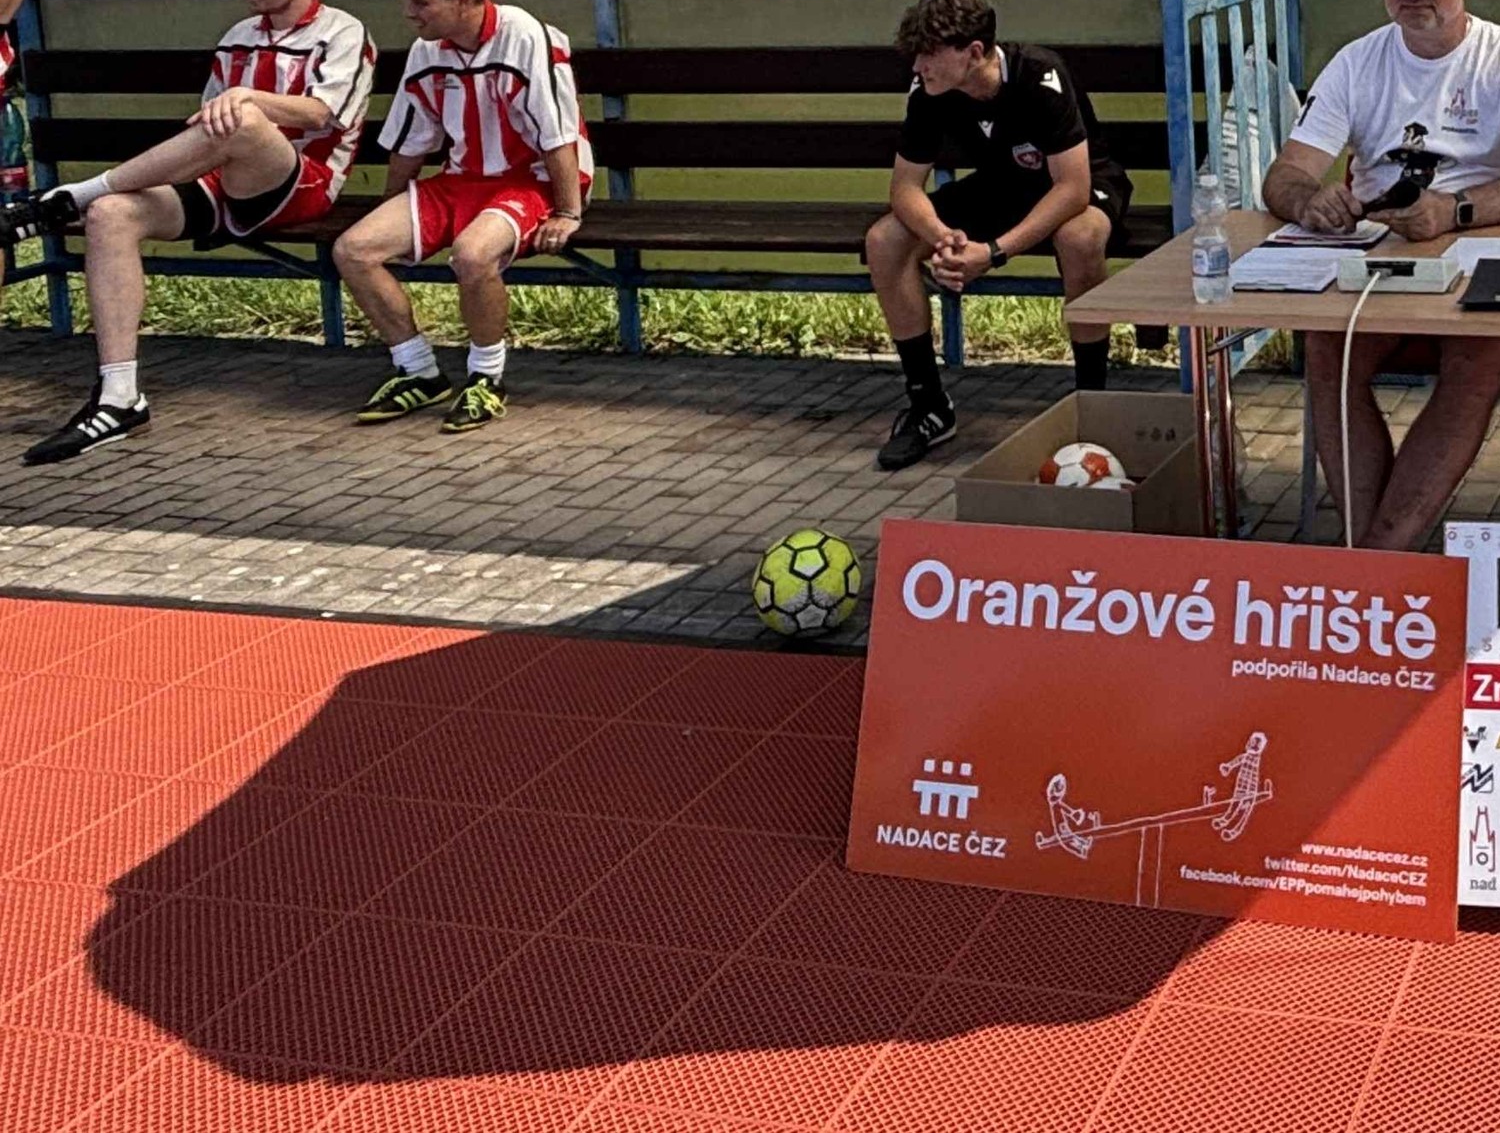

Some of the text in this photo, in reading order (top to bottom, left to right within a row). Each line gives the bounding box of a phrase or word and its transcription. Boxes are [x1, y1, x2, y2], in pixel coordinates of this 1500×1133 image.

[902, 559, 1437, 660] Oranžové hřiště
[1231, 658, 1435, 691] podpořila Nadace ČEZ
[876, 825, 1005, 857] NADACE ČEZ
[1301, 843, 1428, 867] www.nadacecez.cz
[1264, 856, 1428, 887] twitter.com/NadaceCEZ
[1470, 878, 1497, 892] nad
